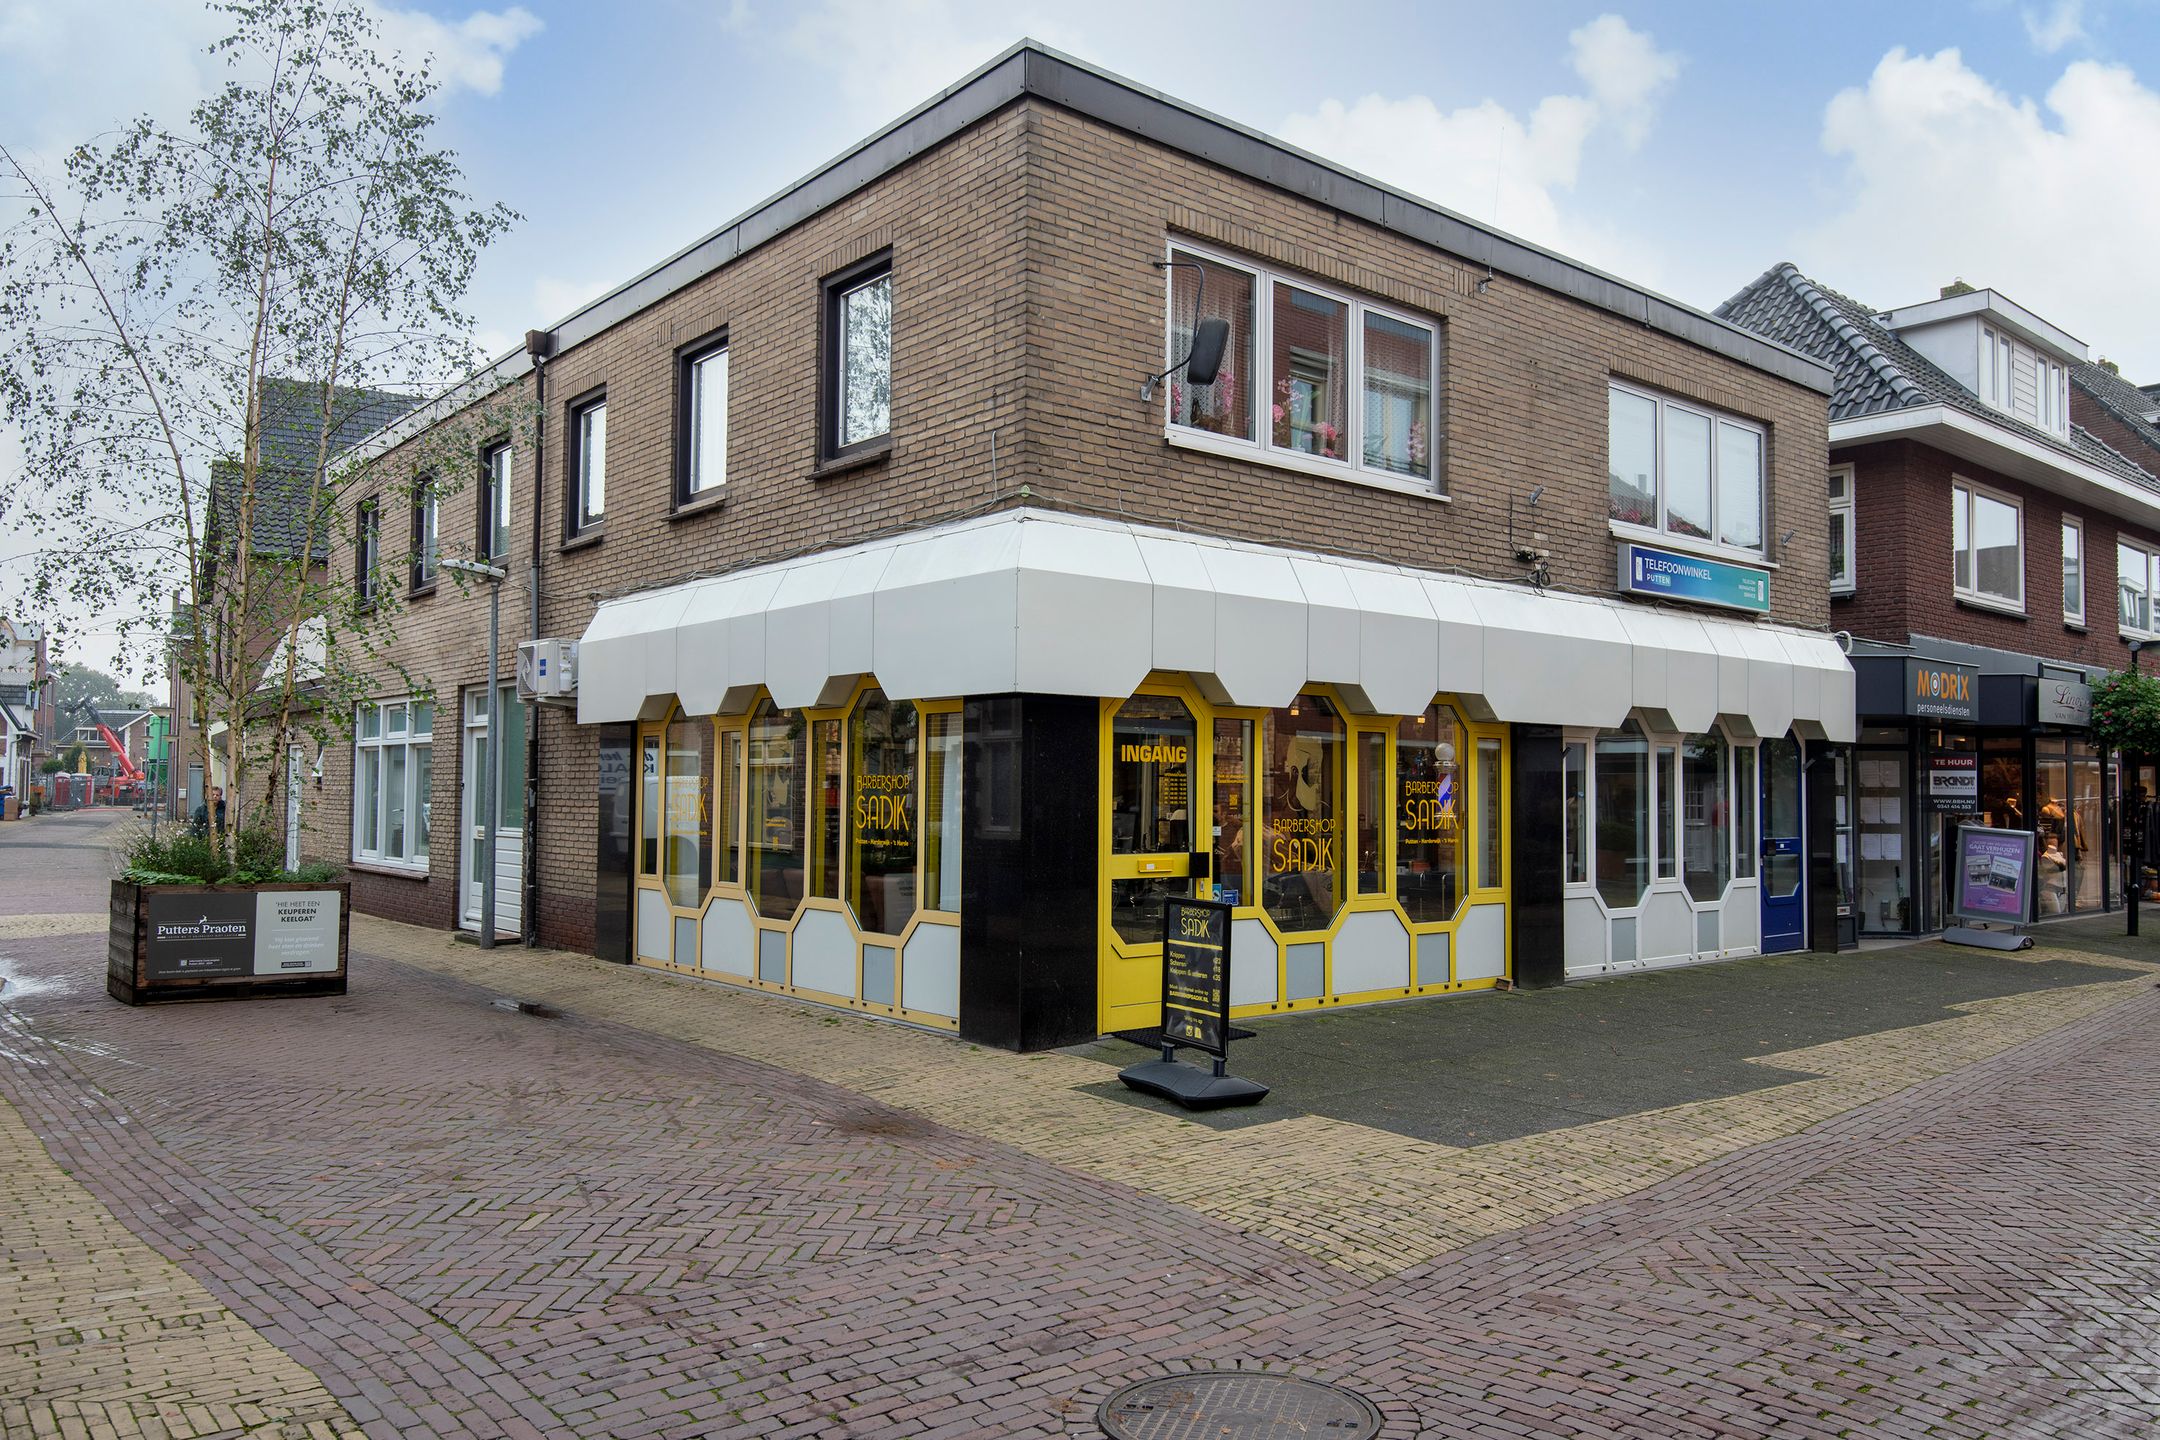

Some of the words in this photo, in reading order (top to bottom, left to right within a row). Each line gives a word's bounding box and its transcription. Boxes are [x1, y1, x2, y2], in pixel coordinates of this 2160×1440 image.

[1645, 558, 1712, 581] TELEFOONWINKEL
[1647, 574, 1670, 585] PUTTEN
[1917, 704, 1970, 717] personeelsdiensten
[1121, 745, 1187, 763] INGANG
[857, 775, 910, 792] BARBERSHOP
[1405, 781, 1459, 796] BARBERSOP
[1933, 776, 1975, 787] BRANDT
[670, 793, 708, 823] SADIK
[856, 795, 909, 831] SADIK
[1405, 799, 1459, 830] SADIK
[1273, 818, 1336, 835] BARBERSHOP
[1273, 838, 1336, 872] SADIK
[1986, 846, 2020, 854] VERHUIZEN
[1181, 906, 1210, 919] BARBERSHOP
[157, 925, 200, 935] Putters
[202, 924, 246, 934] Praoten
[1181, 917, 1211, 939] SADIK
[1169, 950, 1186, 959] Knippen
[1169, 967, 1186, 976] Knippen
